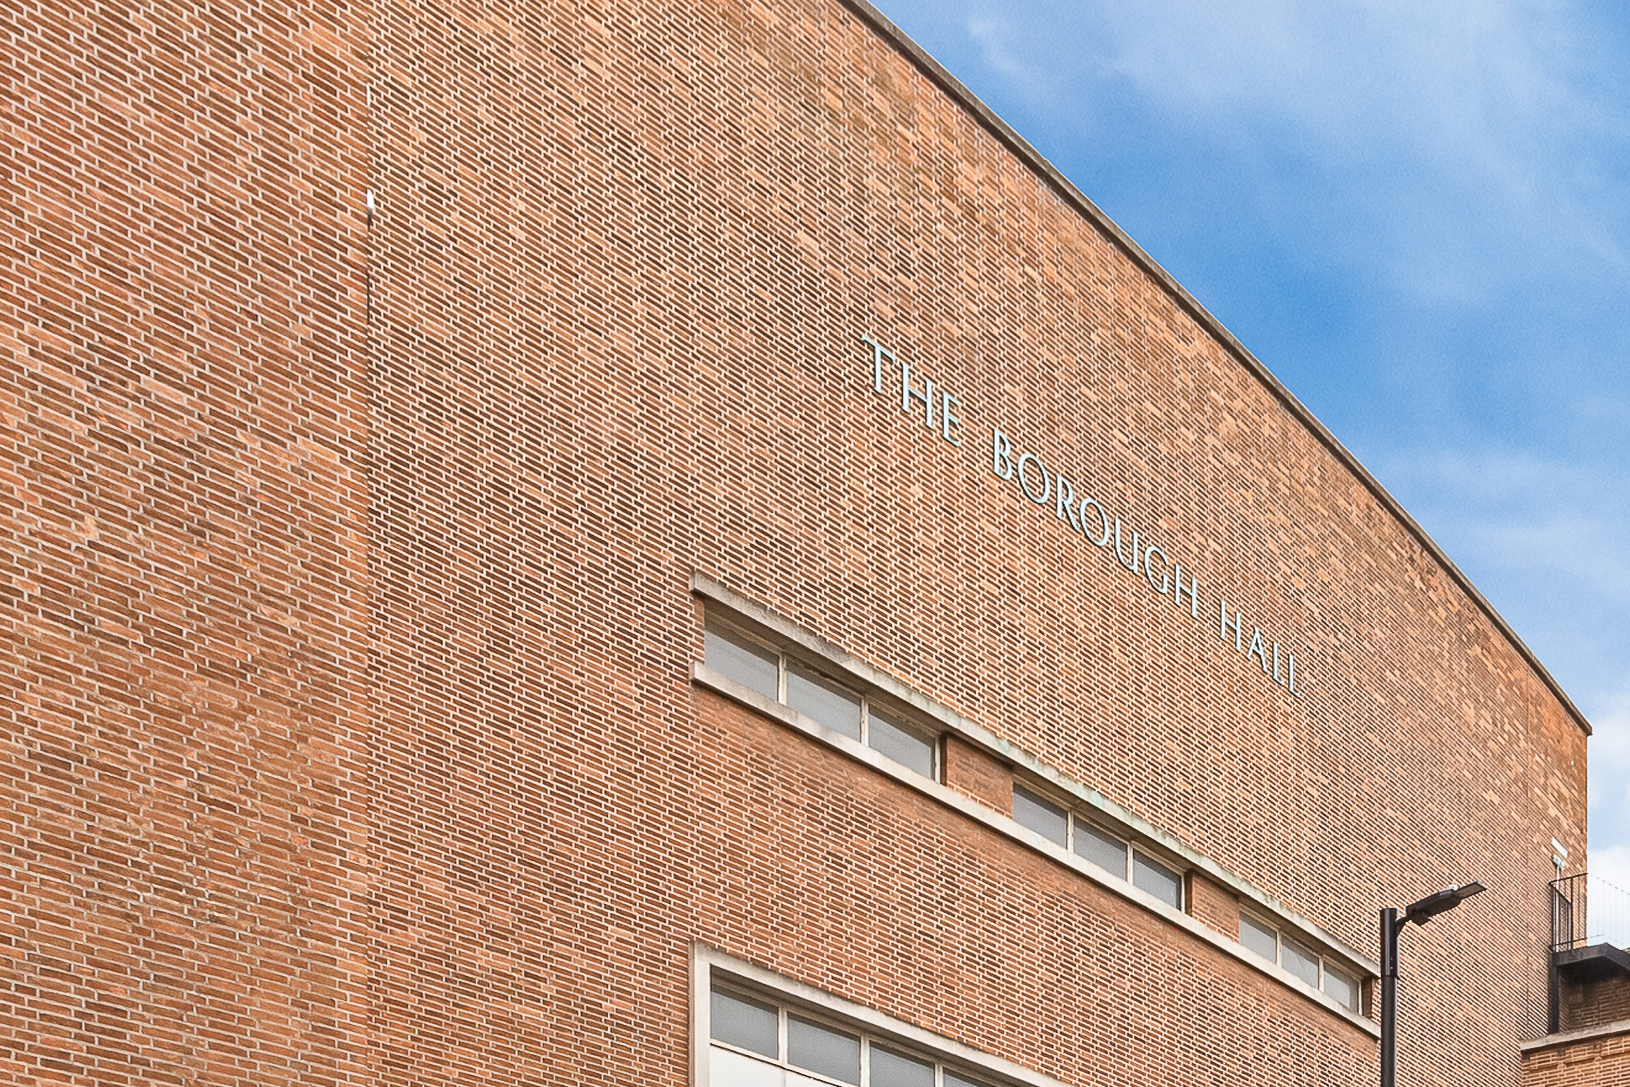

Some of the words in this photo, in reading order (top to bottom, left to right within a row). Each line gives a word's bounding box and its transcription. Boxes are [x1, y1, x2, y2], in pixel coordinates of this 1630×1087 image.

[861, 334, 961, 447] THE
[992, 427, 1198, 618] BOROUGH
[1219, 600, 1300, 697] HALL
